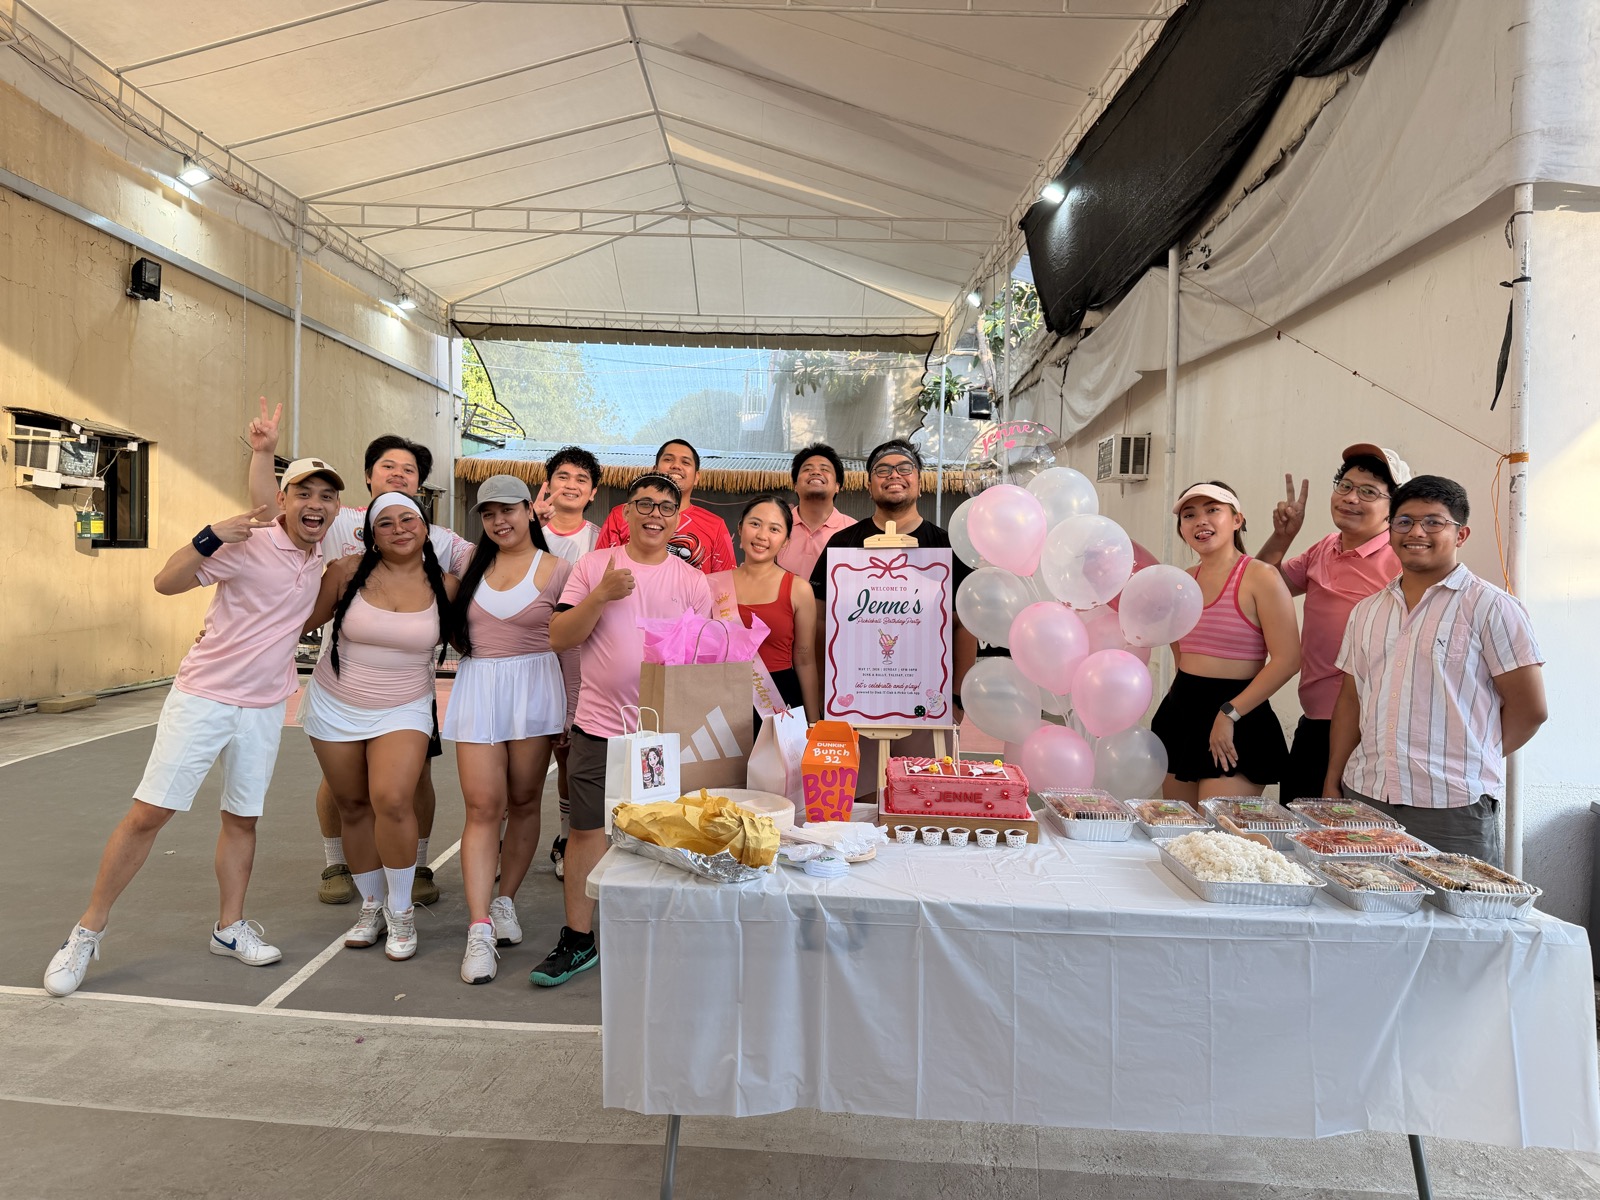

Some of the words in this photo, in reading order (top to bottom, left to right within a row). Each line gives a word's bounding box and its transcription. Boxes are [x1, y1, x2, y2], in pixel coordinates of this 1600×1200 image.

[848, 588, 924, 622] Jenne's
[855, 680, 868, 689] let's
[813, 747, 850, 757] Bunch
[823, 755, 842, 764] 32
[934, 791, 983, 804] JENNE
